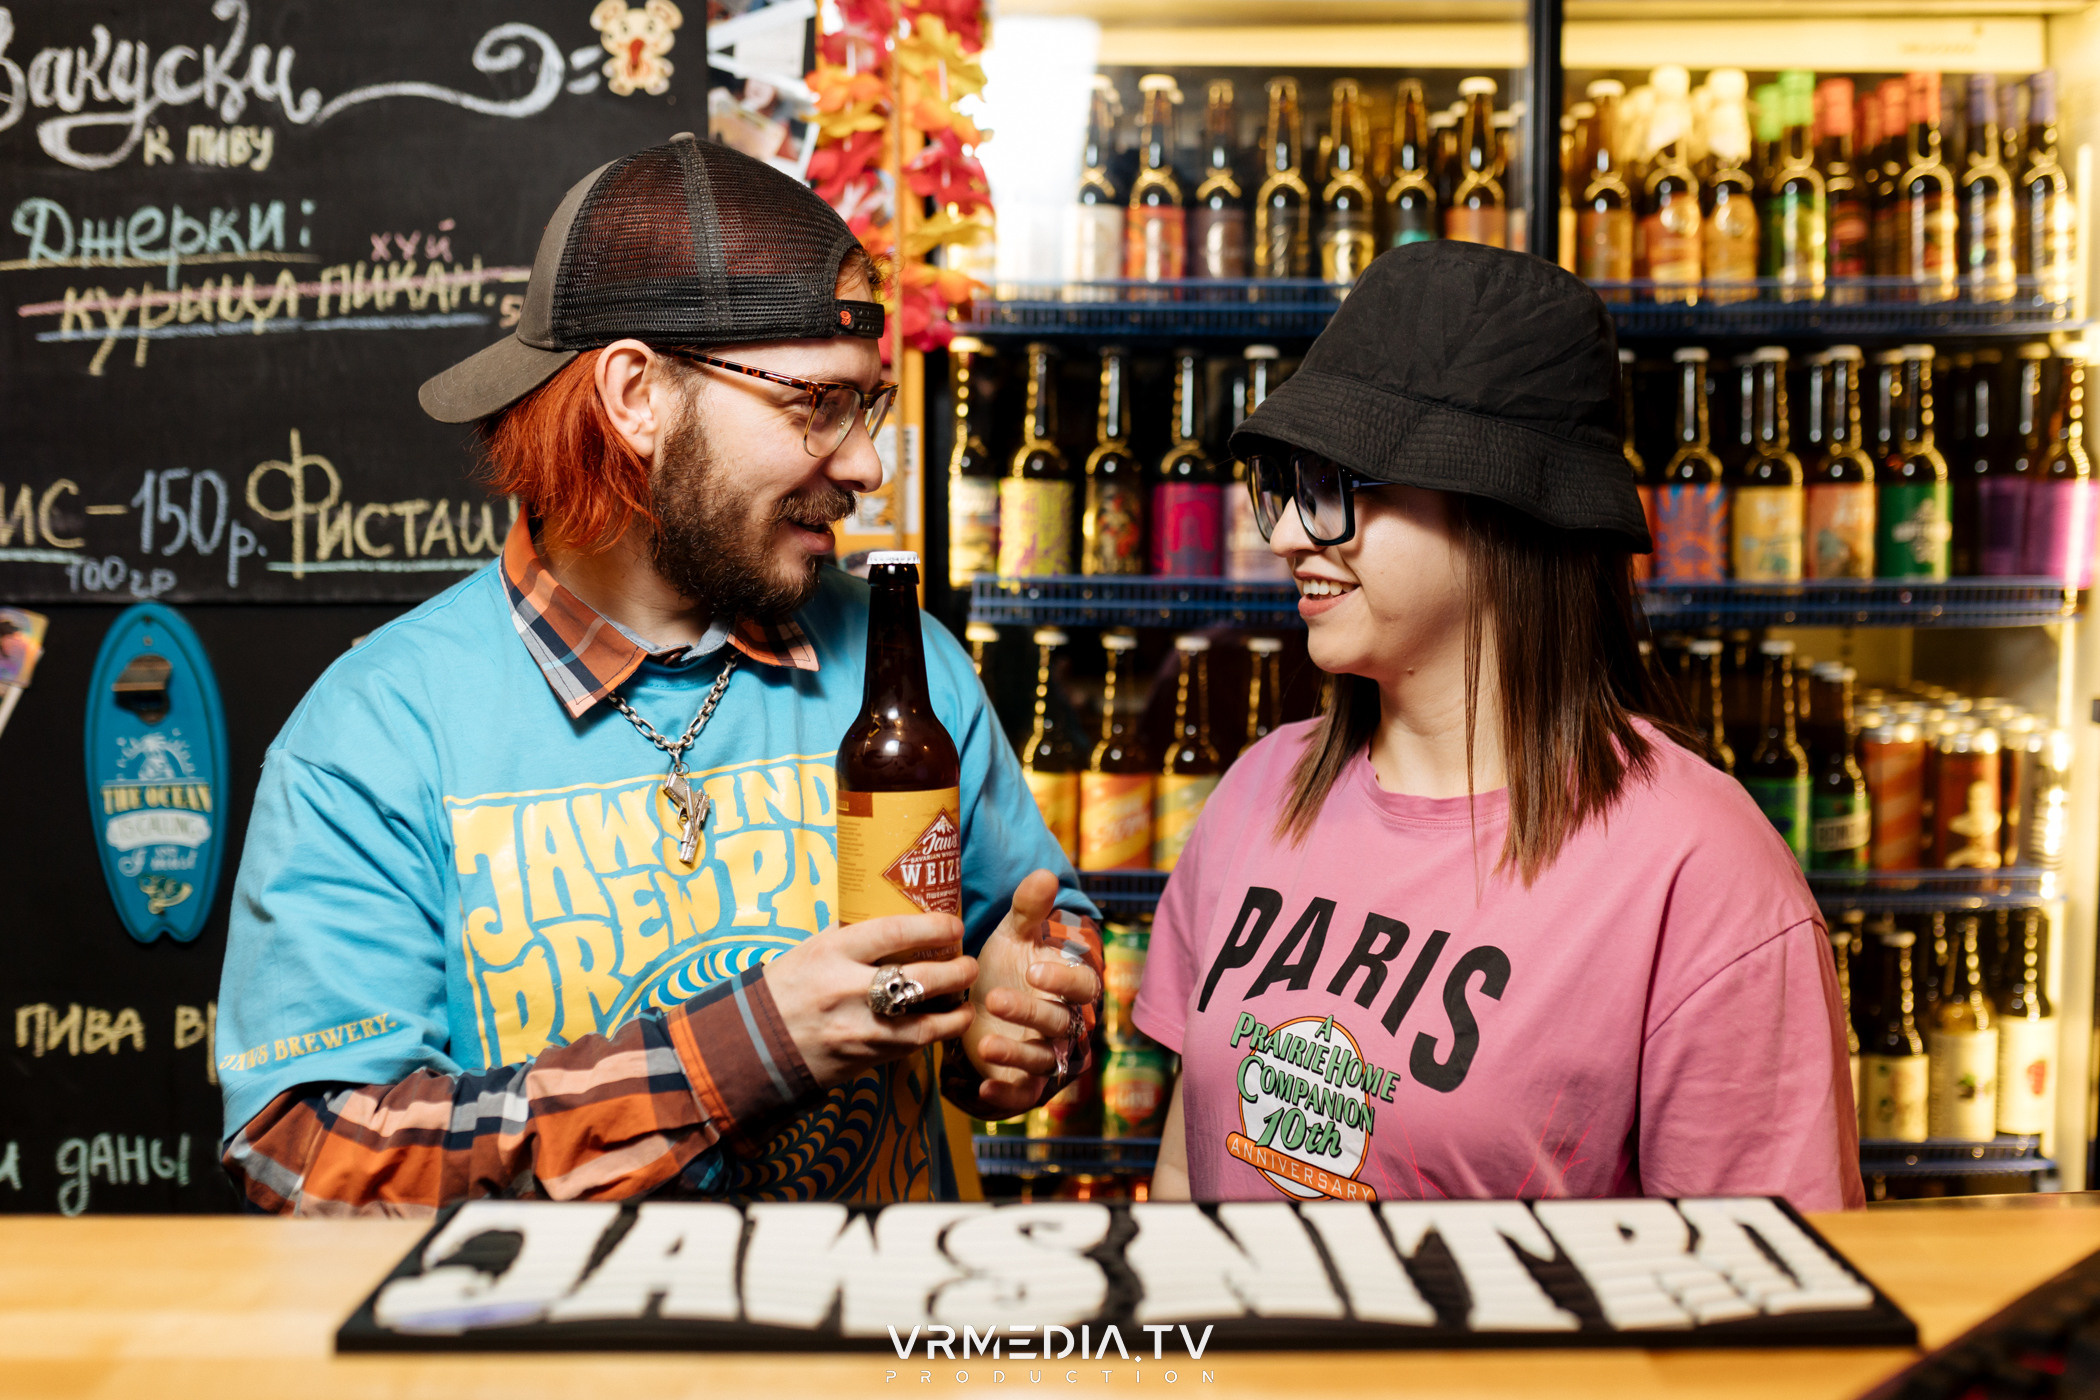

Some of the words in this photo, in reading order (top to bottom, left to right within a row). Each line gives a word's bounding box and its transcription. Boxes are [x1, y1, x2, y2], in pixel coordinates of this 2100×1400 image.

[0, 477, 86, 549] ИС
[702, 762, 838, 835] IND
[714, 827, 838, 936] PA
[1197, 886, 1512, 1094] PARIS
[1315, 1014, 1334, 1042] A
[1237, 1055, 1376, 1136] COMPANION
[1230, 1136, 1371, 1202] ANNIVERSARY
[1255, 1106, 1343, 1159] 10th
[371, 1201, 1111, 1336] JAWS
